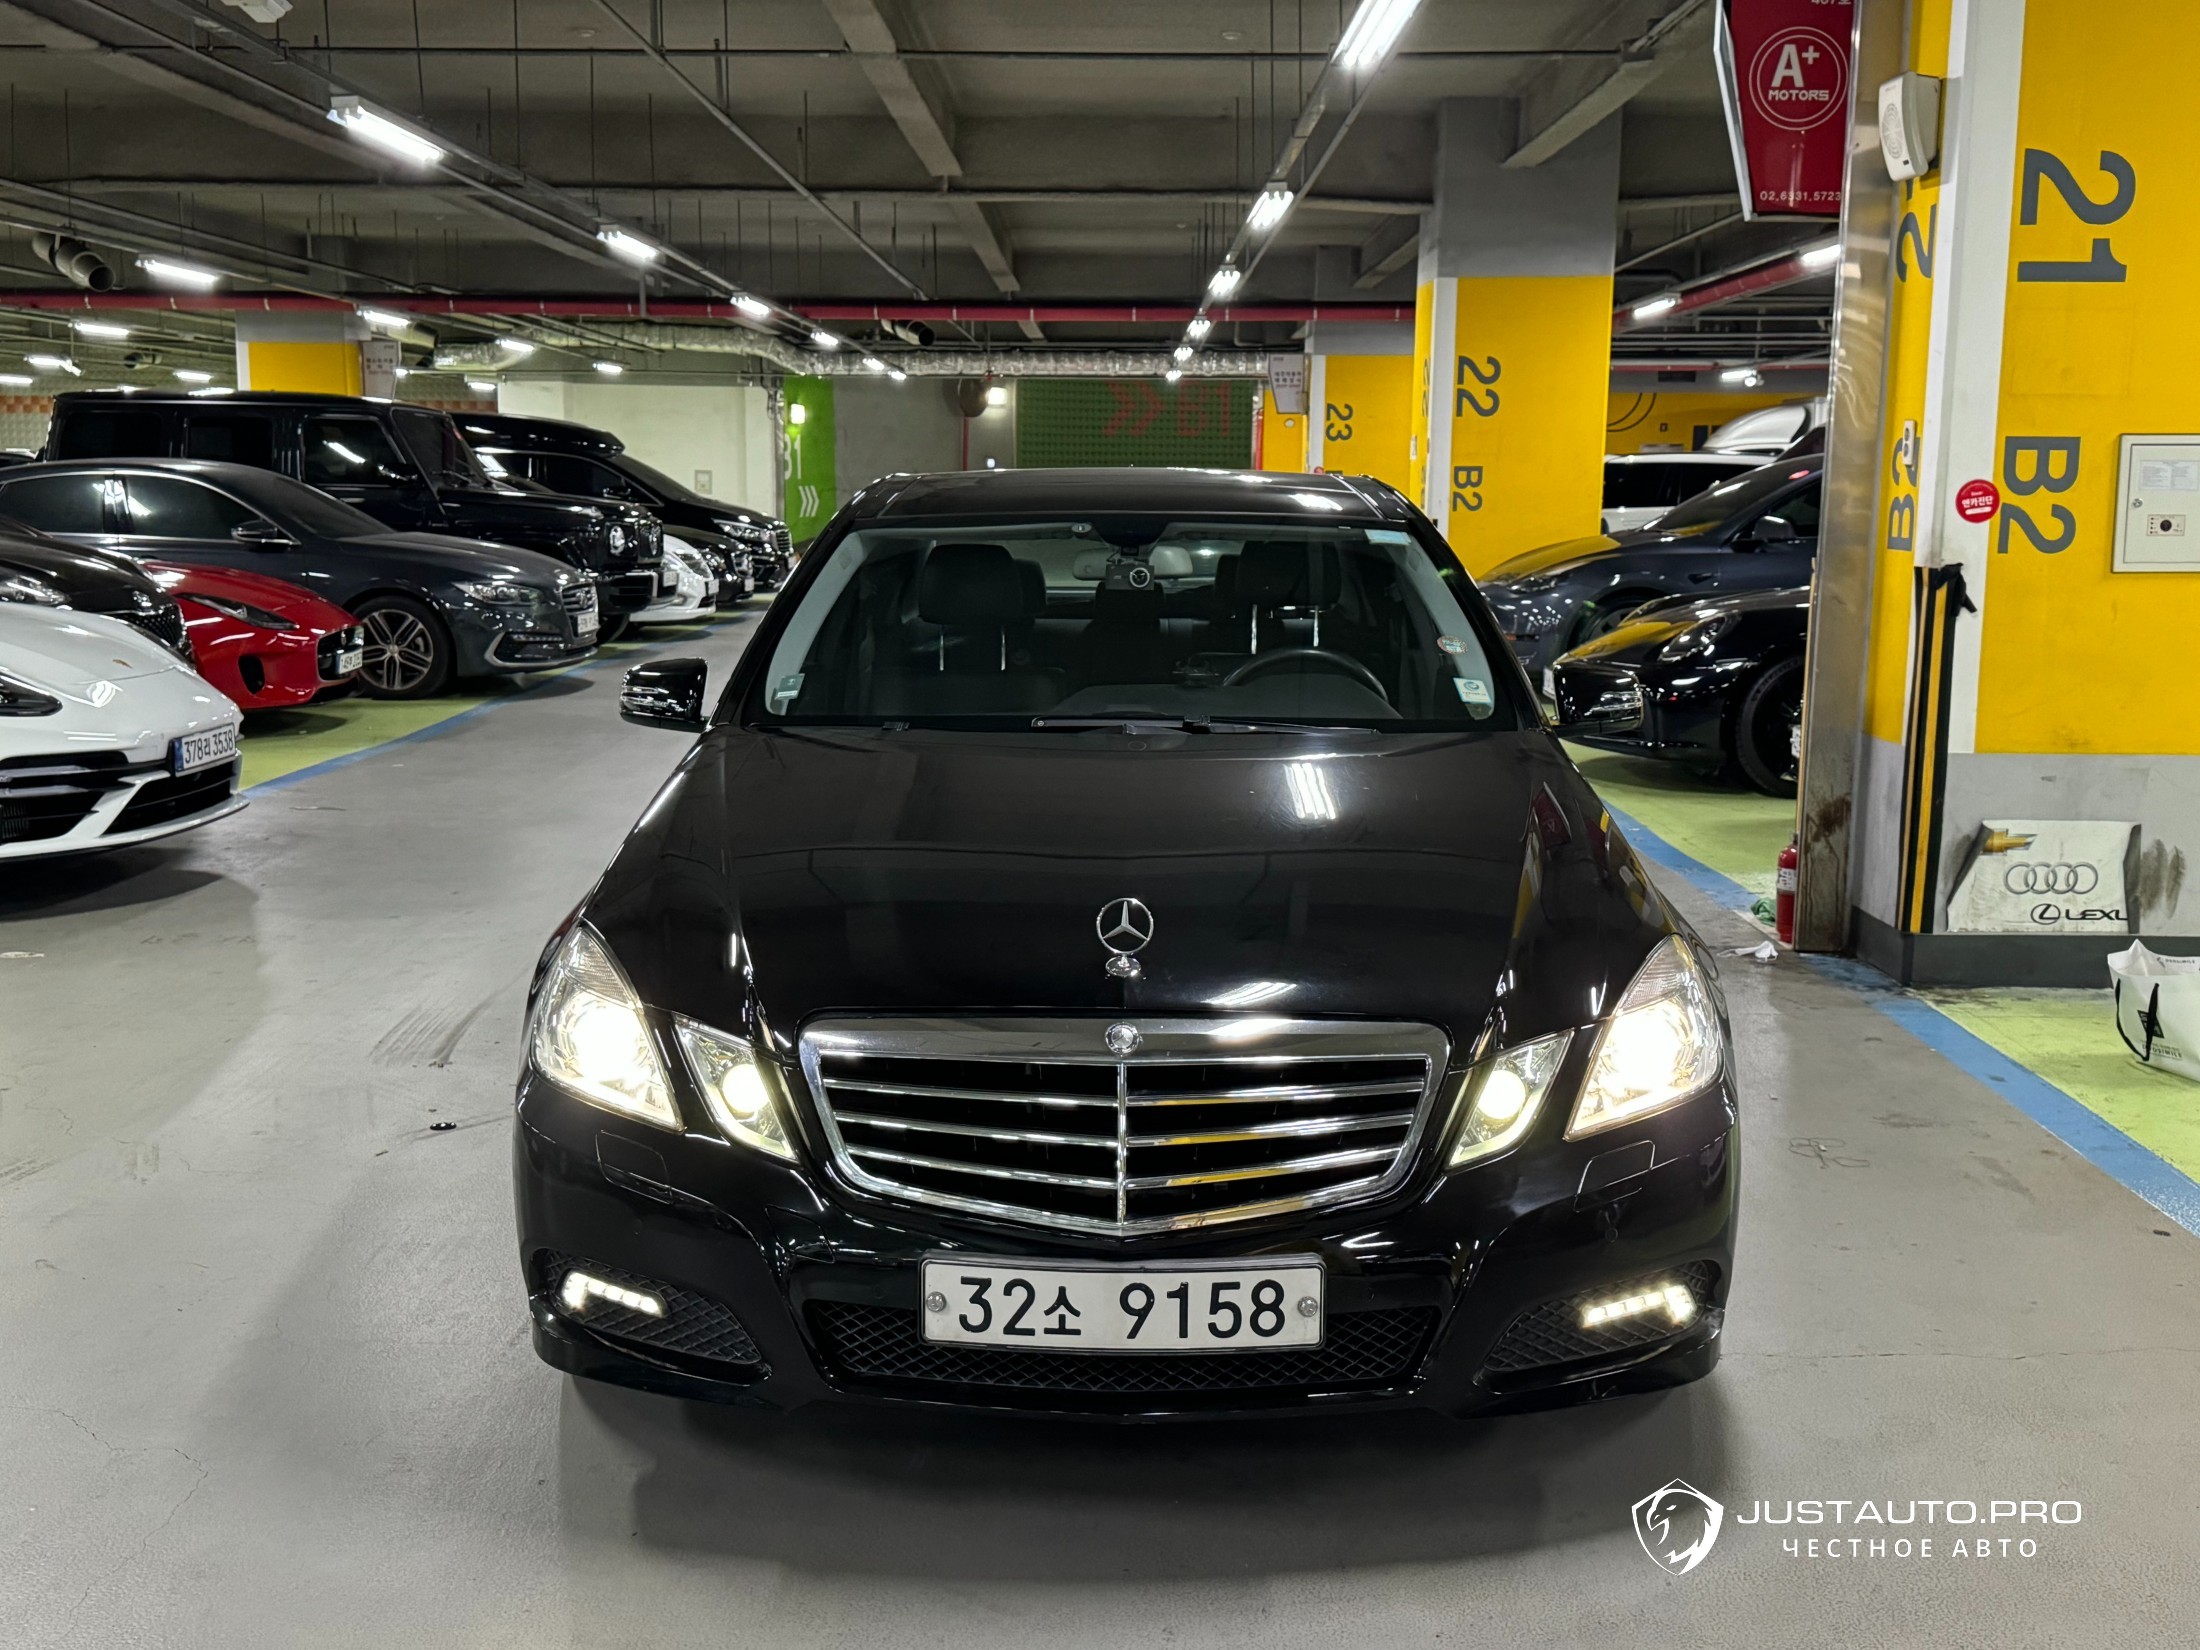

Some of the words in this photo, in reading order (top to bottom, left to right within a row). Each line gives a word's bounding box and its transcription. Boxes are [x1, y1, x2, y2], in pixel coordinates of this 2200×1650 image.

[1771, 44, 1820, 88] A+
[1768, 89, 1830, 101] MOTORS
[2017, 148, 2136, 283] 21
[1455, 355, 1501, 418] 22
[1325, 403, 1354, 442] 23
[1452, 465, 1484, 512] B2
[1998, 436, 2082, 555] B2
[212, 729, 234, 756] 3538
[959, 1275, 1082, 1336] 32소
[1119, 1279, 1286, 1340] 9158
